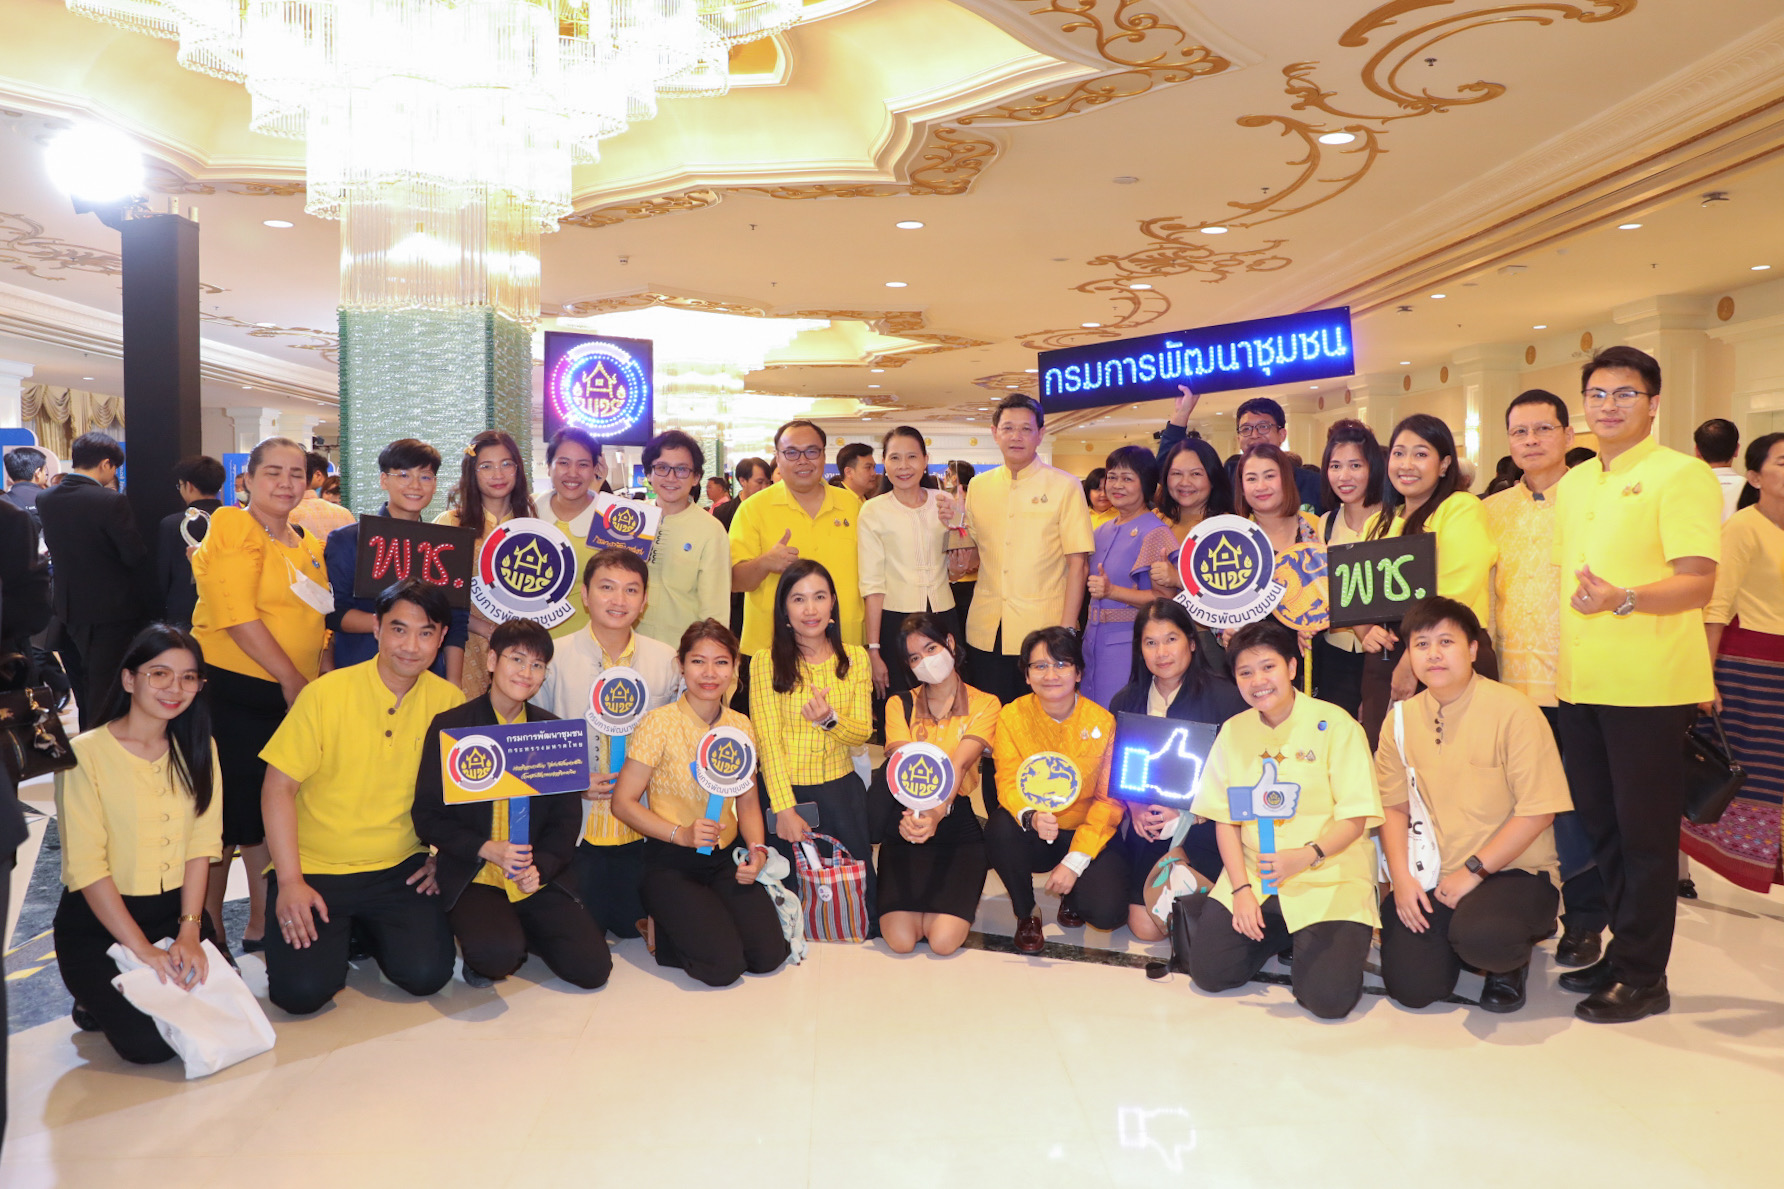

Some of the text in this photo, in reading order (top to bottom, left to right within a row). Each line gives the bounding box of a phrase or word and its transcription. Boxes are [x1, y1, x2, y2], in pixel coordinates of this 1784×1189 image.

[1045, 326, 1347, 396] กรมการพัฒนาชุมชน
[368, 535, 464, 589] พช.
[1334, 554, 1426, 607] พช.
